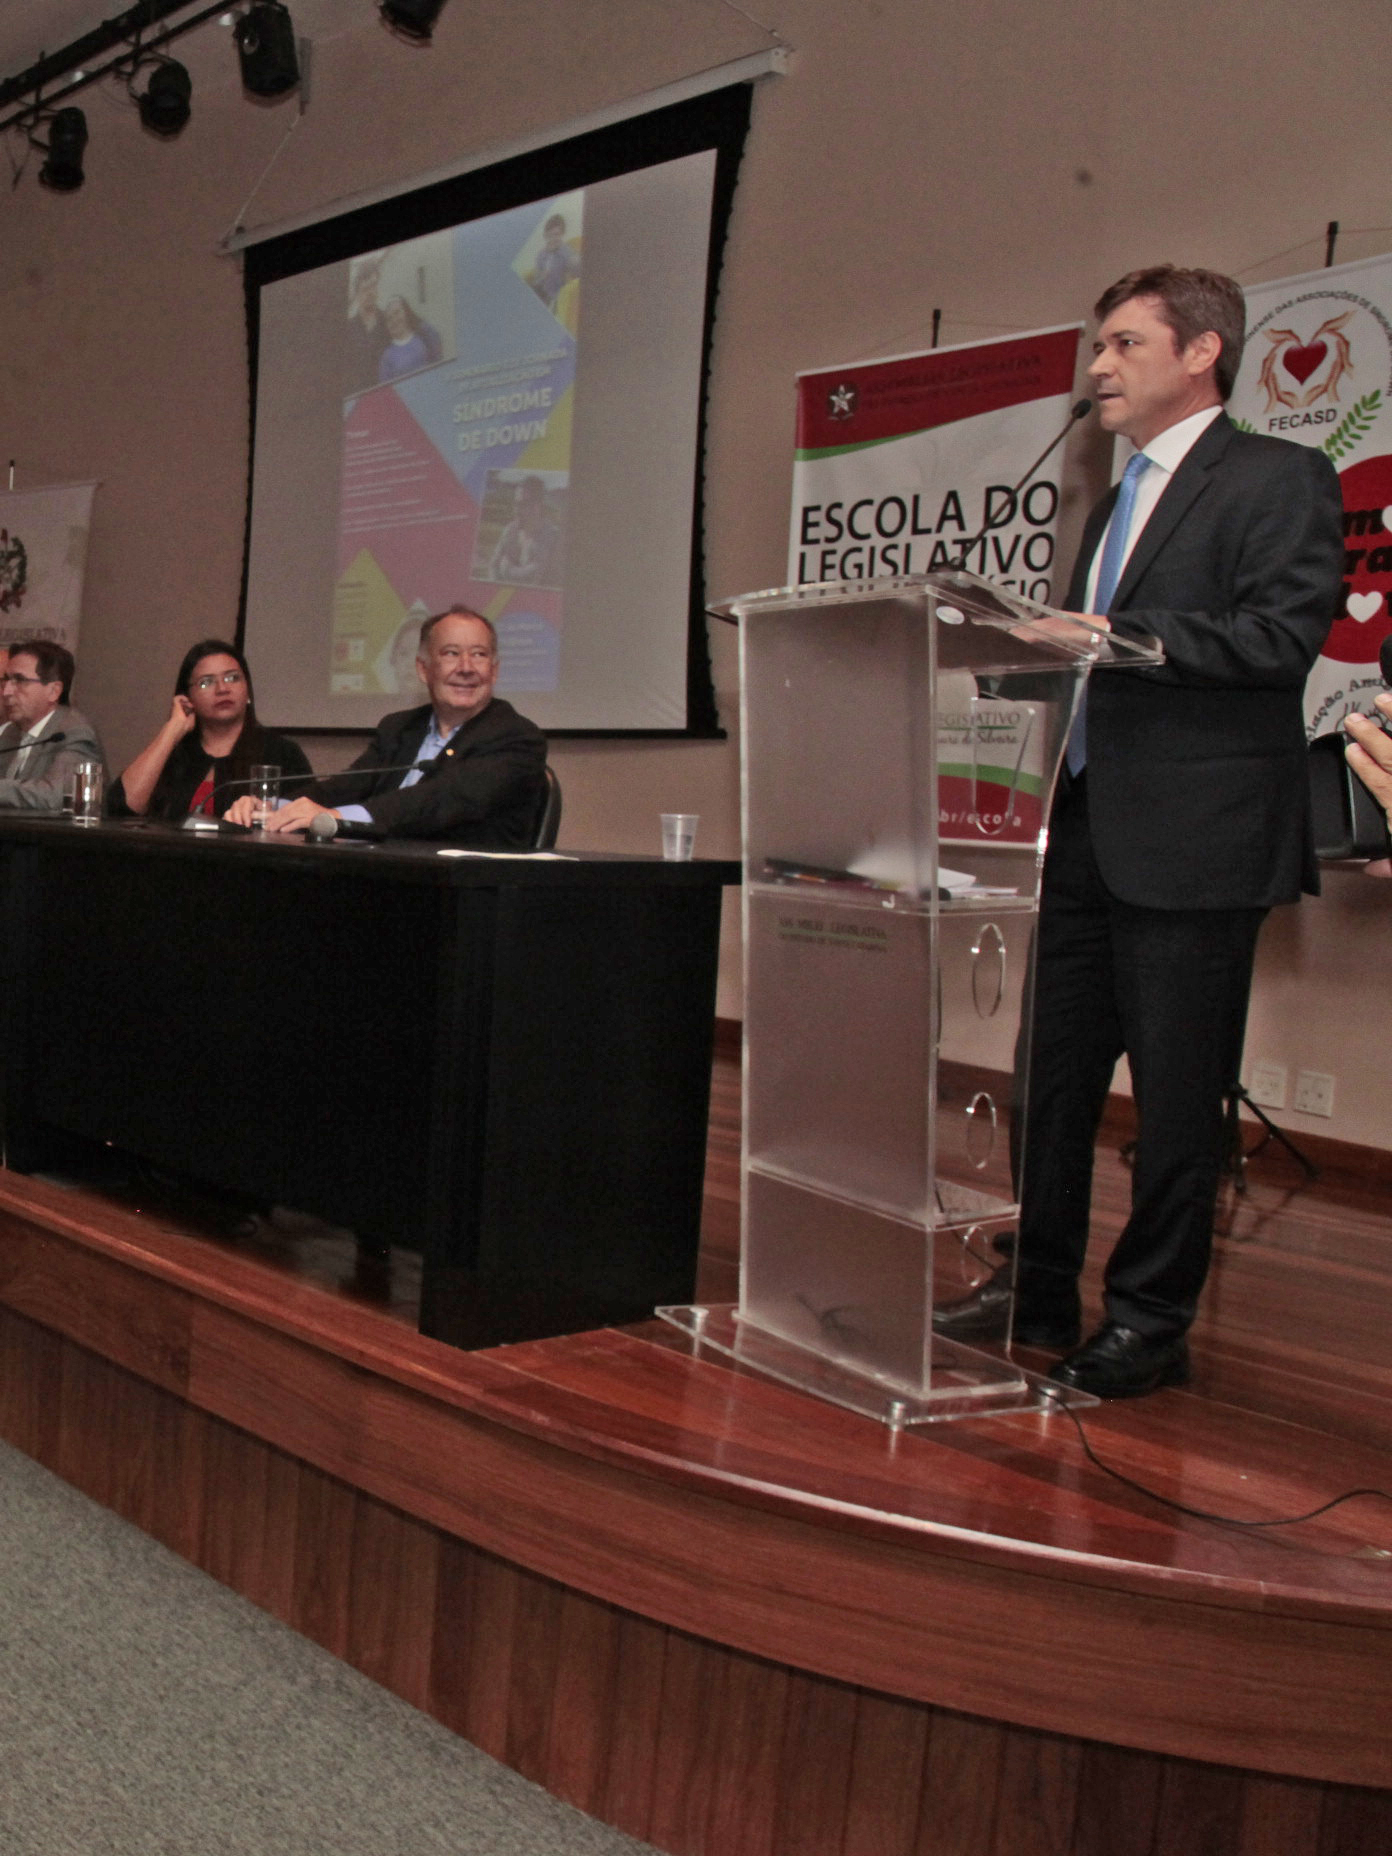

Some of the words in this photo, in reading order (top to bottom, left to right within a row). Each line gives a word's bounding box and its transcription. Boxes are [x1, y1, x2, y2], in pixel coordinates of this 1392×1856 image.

[458, 430, 482, 452] DE
[485, 420, 548, 447] DOWN
[1268, 408, 1338, 432] FECASD
[800, 490, 966, 546] ESCOLA
[983, 481, 1059, 530] DO
[798, 531, 1055, 585] LEGISLATIVO
